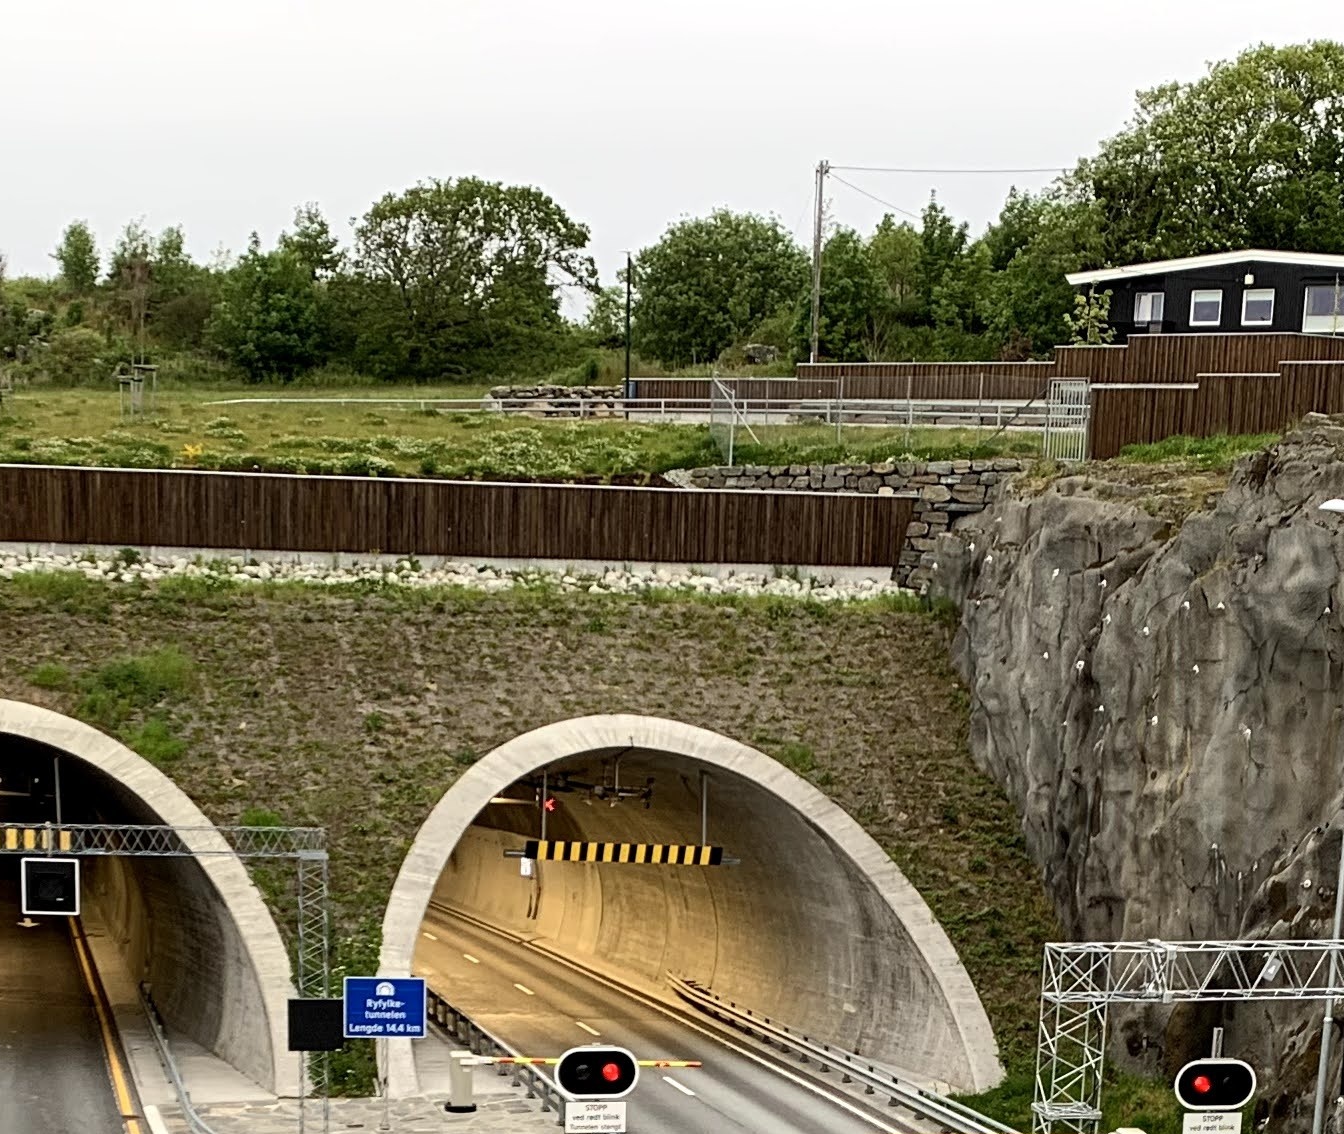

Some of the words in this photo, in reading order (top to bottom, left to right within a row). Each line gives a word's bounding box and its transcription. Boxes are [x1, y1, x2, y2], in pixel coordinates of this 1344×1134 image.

[364, 1010, 407, 1019] tunnelen
[349, 1023, 383, 1034] Lengde
[386, 1023, 404, 1033] 14,4
[406, 1024, 421, 1033] km
[585, 1104, 608, 1112] STOPP
